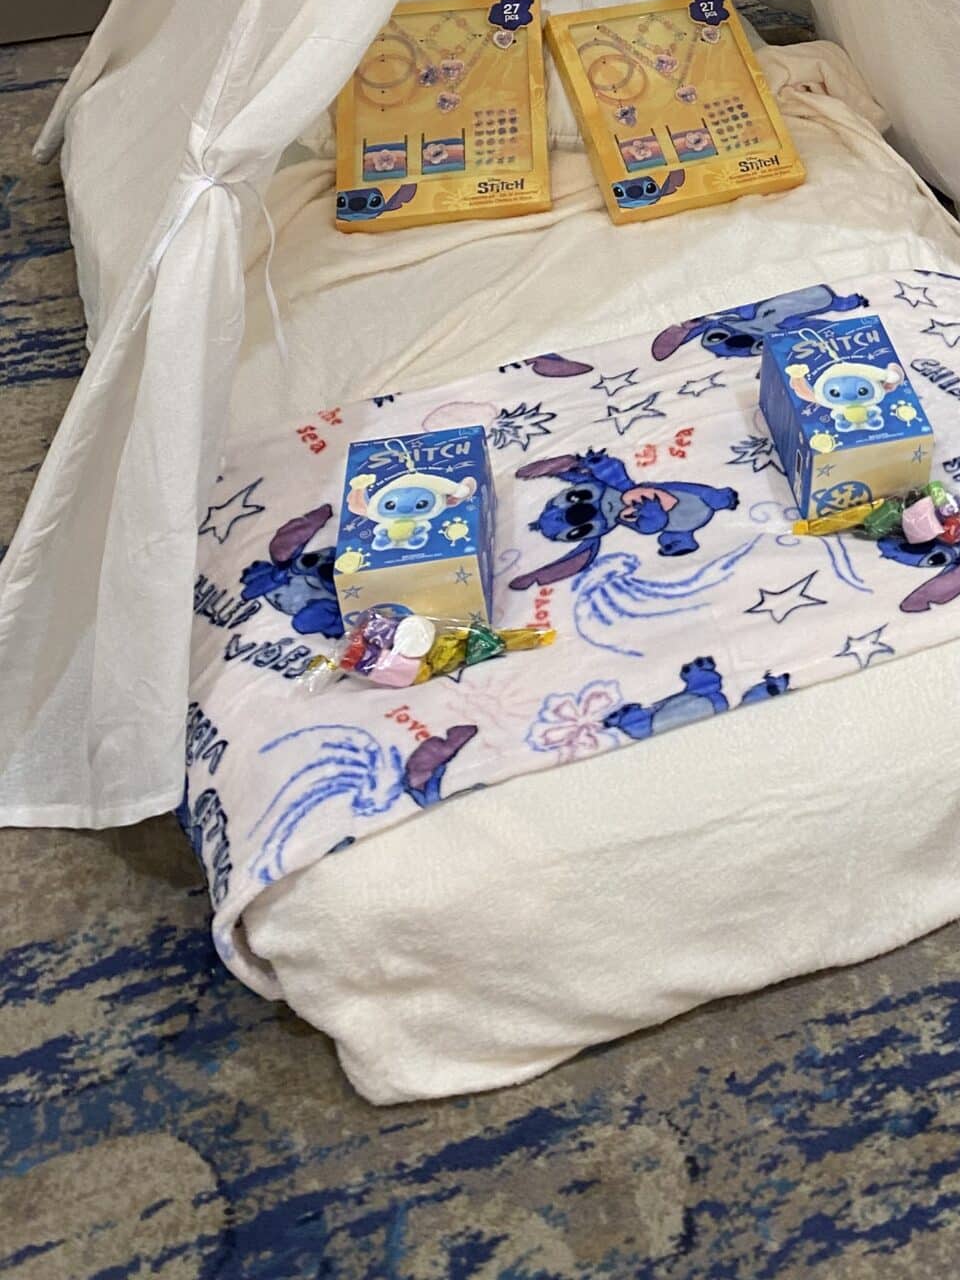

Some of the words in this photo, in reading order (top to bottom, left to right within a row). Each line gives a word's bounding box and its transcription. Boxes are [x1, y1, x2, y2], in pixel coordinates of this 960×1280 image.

[503, 3, 521, 15] 27
[699, 1, 714, 13] 27
[504, 14, 520, 23] pcs
[525, 587, 554, 629] love
[384, 705, 431, 741] love
